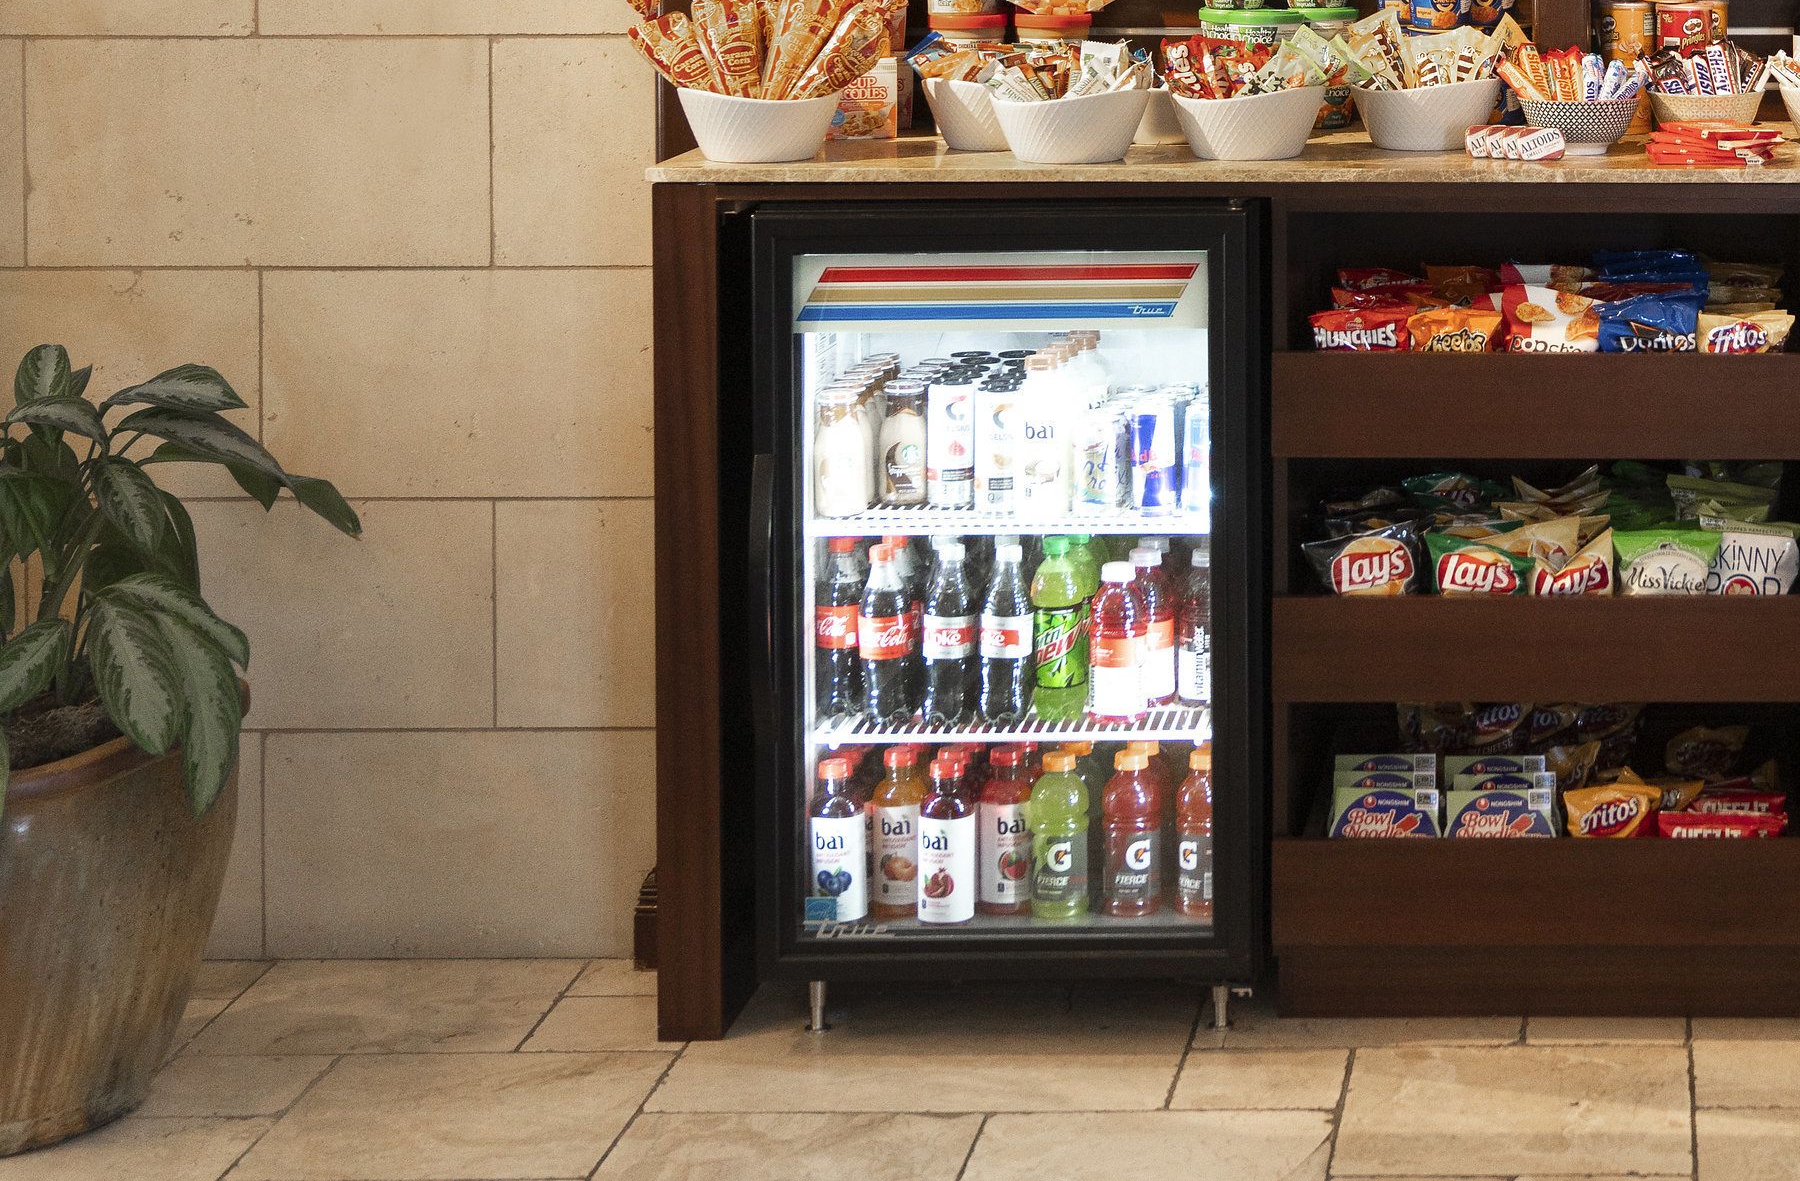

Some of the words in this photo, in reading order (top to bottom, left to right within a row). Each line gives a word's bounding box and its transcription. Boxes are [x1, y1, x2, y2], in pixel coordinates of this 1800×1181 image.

[1682, 32, 1706, 49] Pringles
[719, 48, 756, 62] Caramel
[728, 58, 751, 66] Corn
[852, 76, 877, 88] CUP
[1520, 128, 1560, 154] ALTOIDS
[1128, 304, 1166, 316] true
[1312, 323, 1397, 350] MUNCHIES
[1425, 328, 1486, 352] heetos
[1620, 332, 1696, 352] Doritos
[1708, 322, 1767, 354] Fritos
[1340, 548, 1406, 594] Lay's
[1442, 553, 1511, 593] Lay's
[1626, 566, 1662, 590] Miss
[1377, 799, 1410, 807] NONGSHIM
[1490, 800, 1523, 808] NONGSHIM
[881, 814, 912, 836] bai
[997, 816, 1026, 835] bai
[1348, 808, 1396, 826] Bowl
[1462, 810, 1508, 827] Bowl
[1579, 797, 1640, 834] Fritos
[816, 831, 844, 850] bai
[922, 830, 950, 850] bai
[1046, 841, 1072, 872] G
[1125, 838, 1152, 870] G
[1178, 840, 1198, 870] G
[1036, 875, 1070, 886] FIERCE
[1114, 874, 1149, 885] FIERCE
